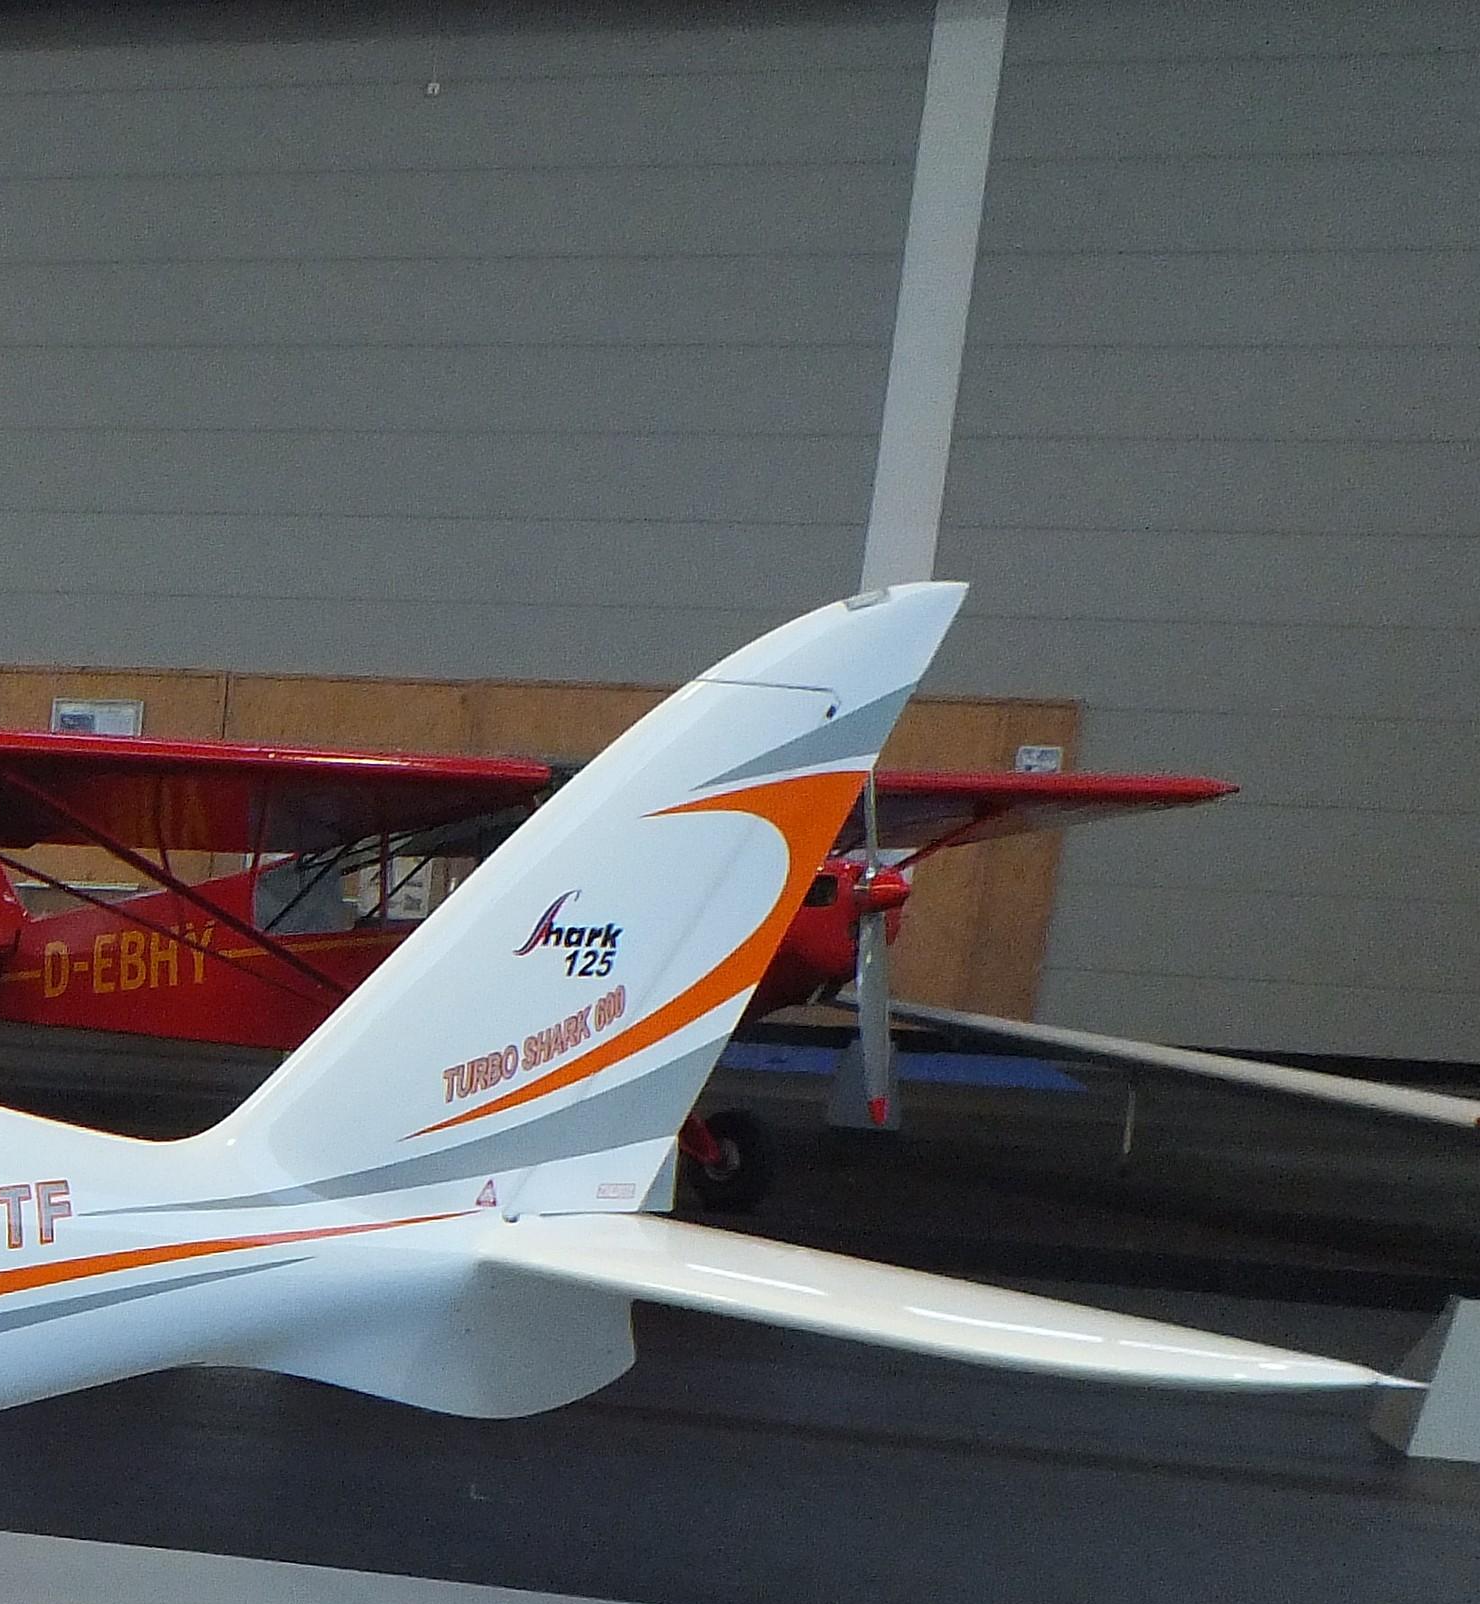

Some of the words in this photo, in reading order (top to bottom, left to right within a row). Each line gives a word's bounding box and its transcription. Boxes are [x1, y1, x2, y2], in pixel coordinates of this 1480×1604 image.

[43, 920, 216, 999] D-EBHY
[511, 889, 624, 957] Shark
[565, 949, 617, 978] 125
[443, 1044, 519, 1104] TURBO
[521, 1004, 593, 1071] SHARK
[594, 984, 627, 1033] 600
